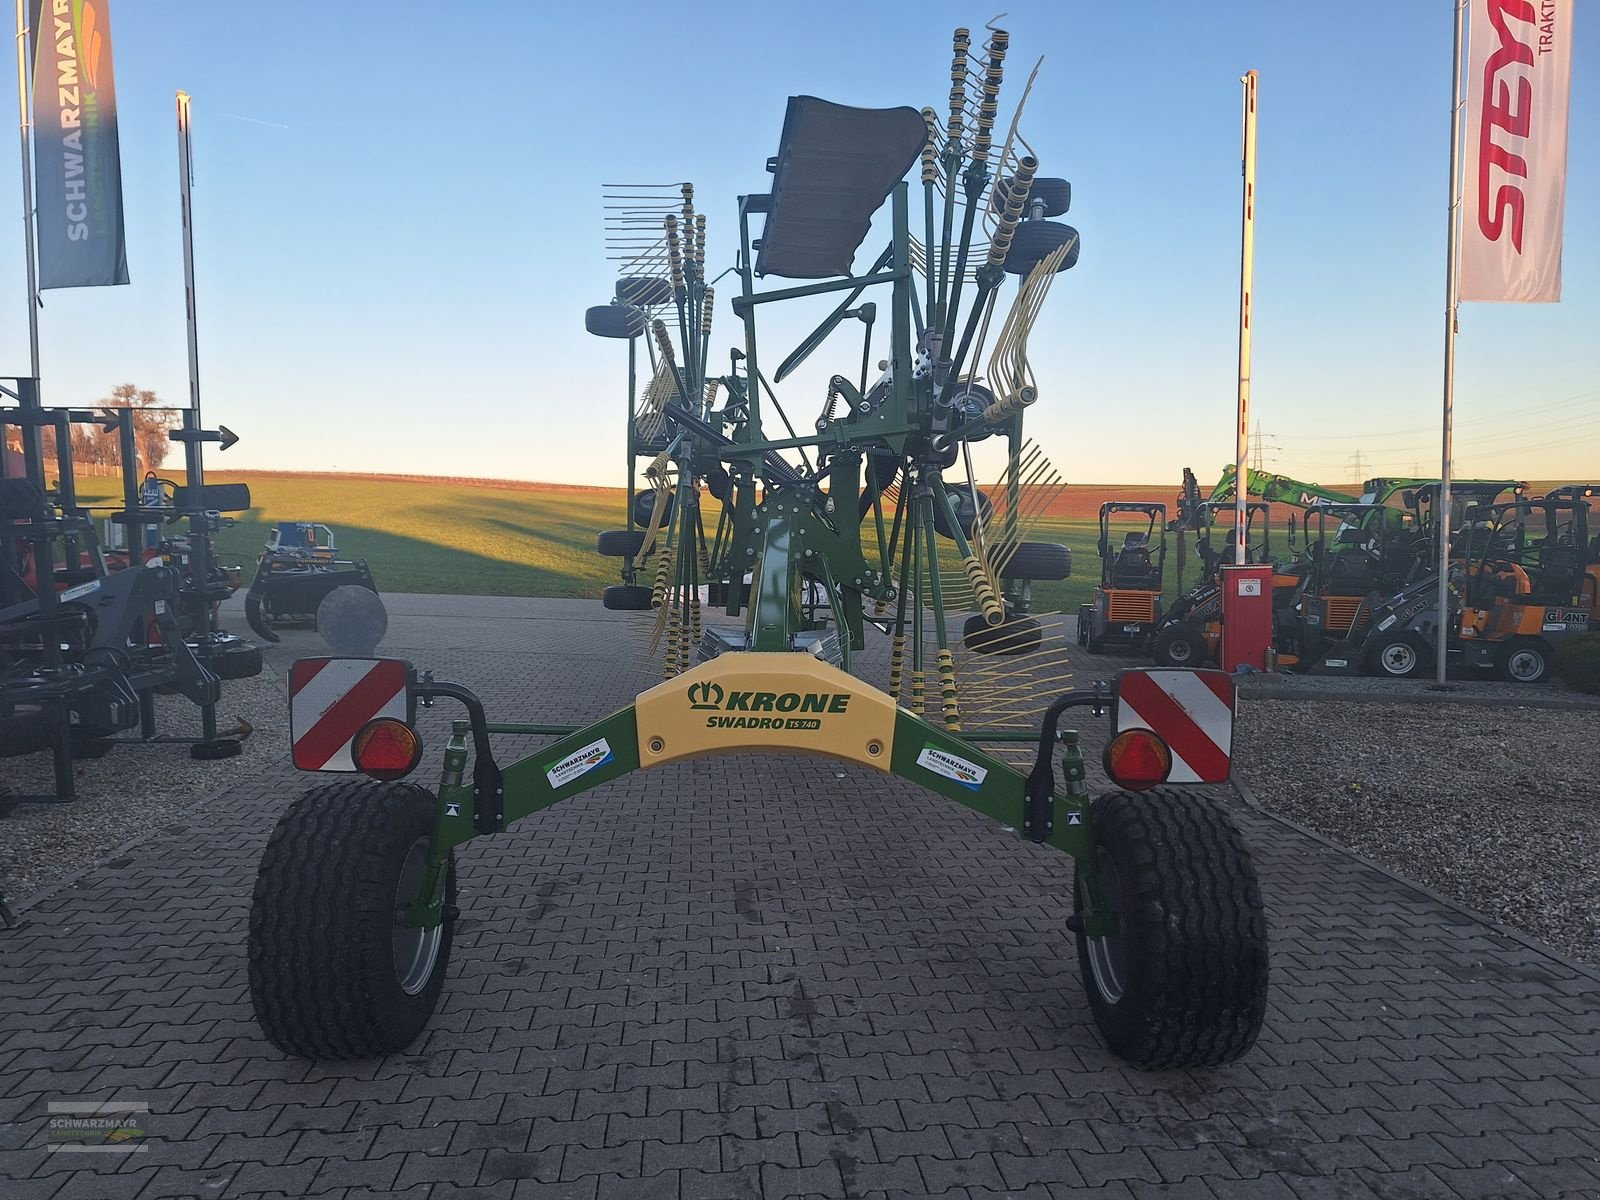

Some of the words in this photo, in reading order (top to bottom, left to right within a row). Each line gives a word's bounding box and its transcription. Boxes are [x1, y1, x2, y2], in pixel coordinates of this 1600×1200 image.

[1538, 0, 1555, 57] TRAKT
[52, 0, 89, 242] SCHWARZMAYR
[726, 691, 852, 713] KRONE
[706, 716, 785, 729] SWADRO
[789, 719, 799, 728] TS
[802, 720, 817, 728] 740
[551, 747, 600, 774] SCHWARZMAYR
[927, 750, 977, 776] SCHWARZMAYR
